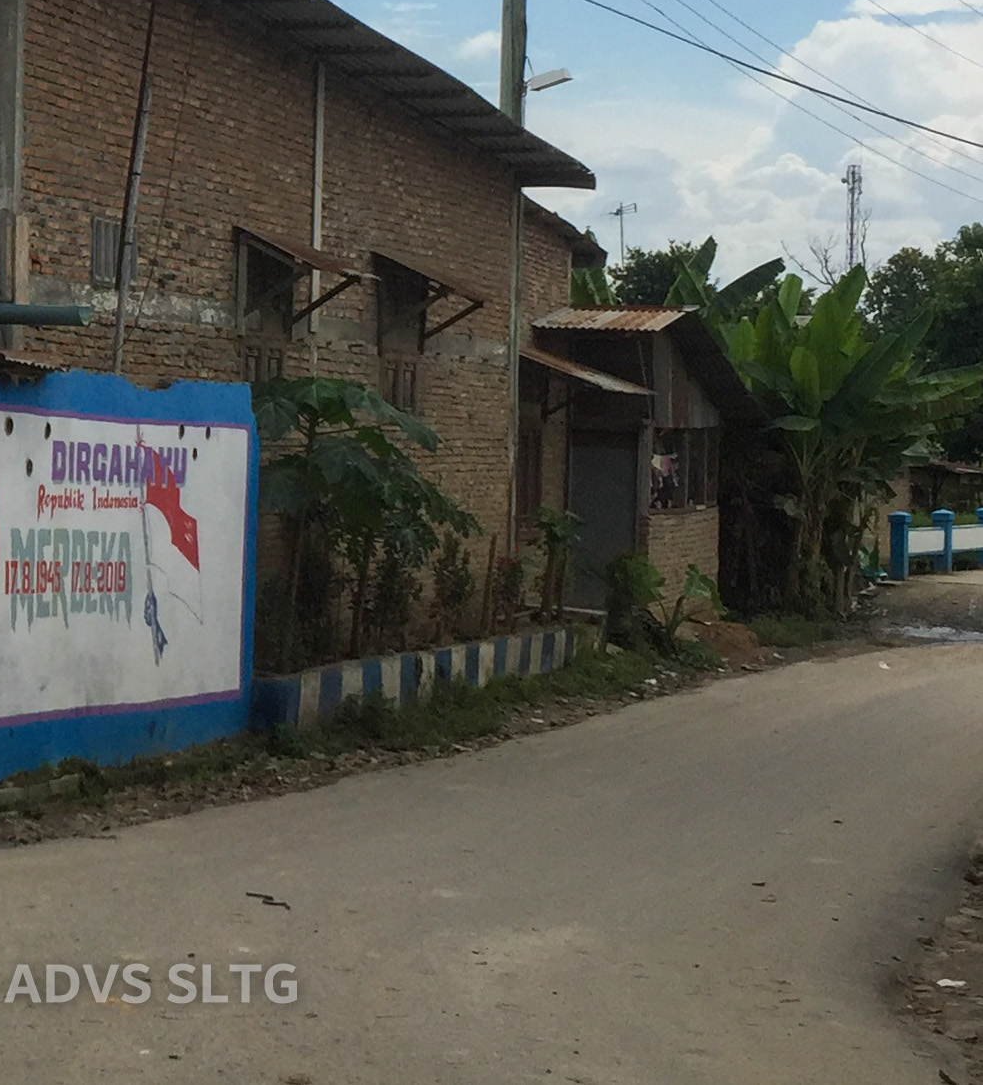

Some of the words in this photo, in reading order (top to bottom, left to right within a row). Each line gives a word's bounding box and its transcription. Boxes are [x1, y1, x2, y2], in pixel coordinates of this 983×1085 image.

[51, 440, 187, 487] DIRGAHAYU
[37, 484, 84, 521] Republik
[92, 486, 138, 511] Indonesia
[5, 560, 61, 594] 17.8.1945
[71, 561, 127, 593] 17.8.2019
[10, 528, 133, 633] MERDEKA
